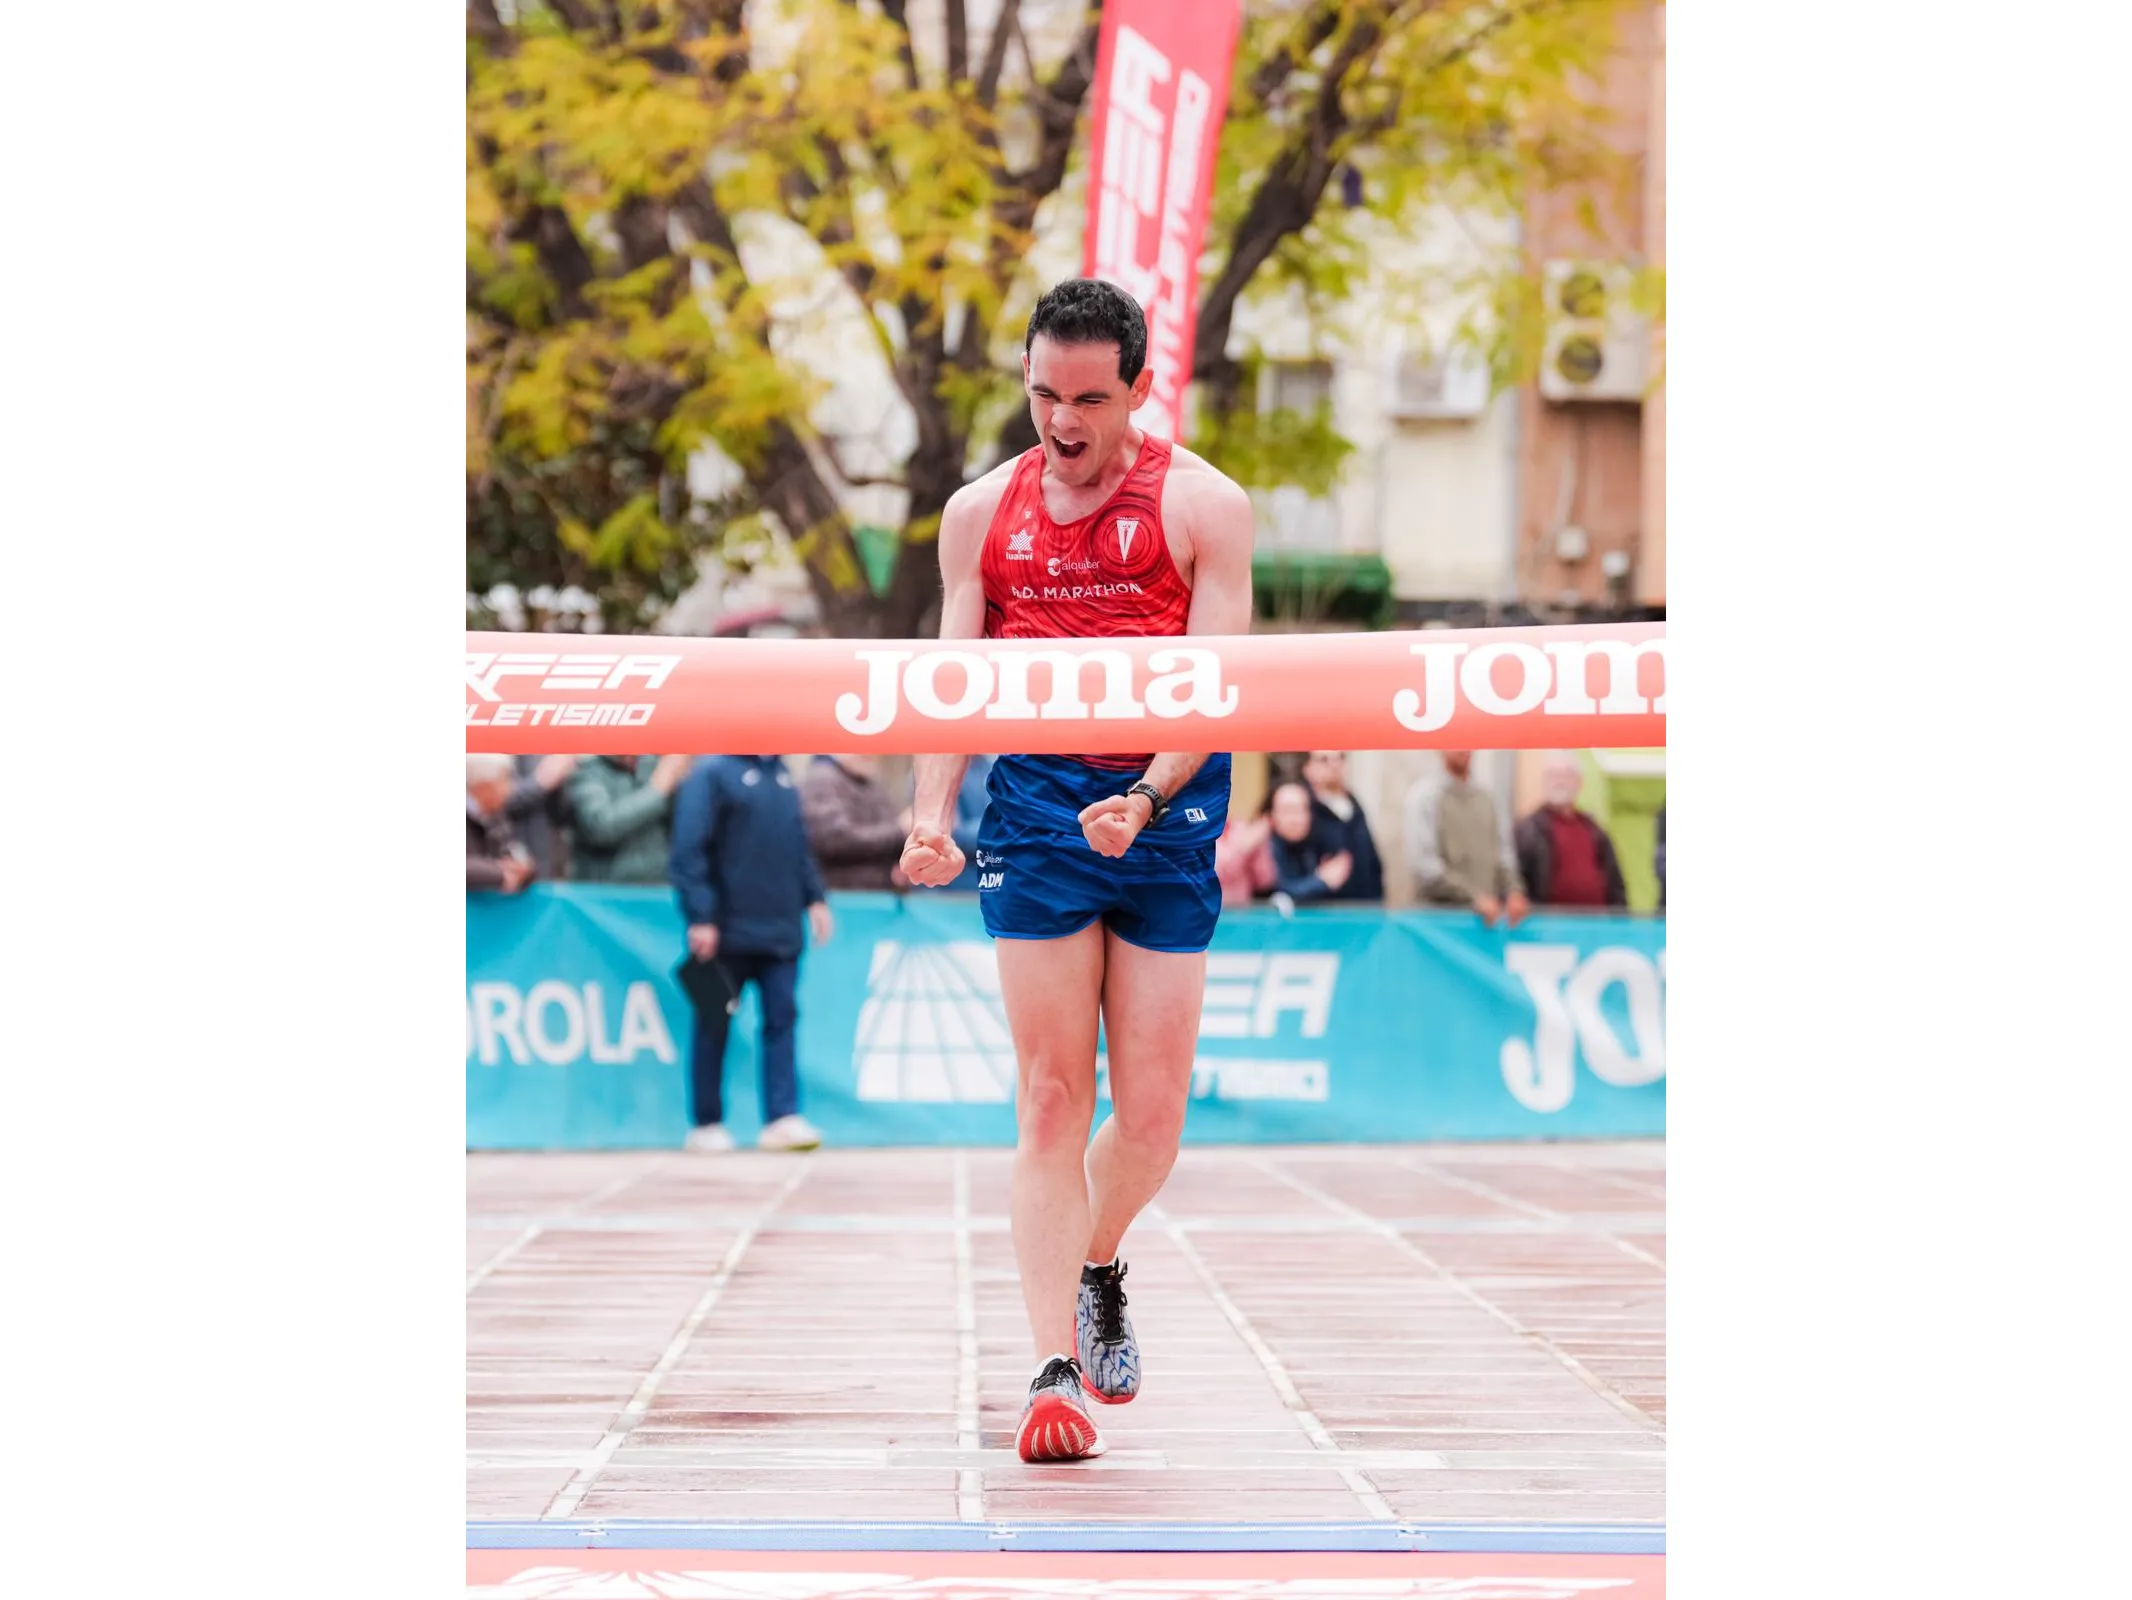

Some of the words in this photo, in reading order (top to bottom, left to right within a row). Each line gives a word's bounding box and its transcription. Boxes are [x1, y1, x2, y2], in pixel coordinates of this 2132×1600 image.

[1096, 25, 1172, 309] FEA
[1006, 551, 1033, 560] luanvi
[1043, 583, 1143, 599] MARATHON
[466, 703, 656, 726] LETISMO
[978, 872, 1004, 888] ADM
[1198, 951, 1341, 1039] EA
[466, 979, 677, 1066] ROLA
